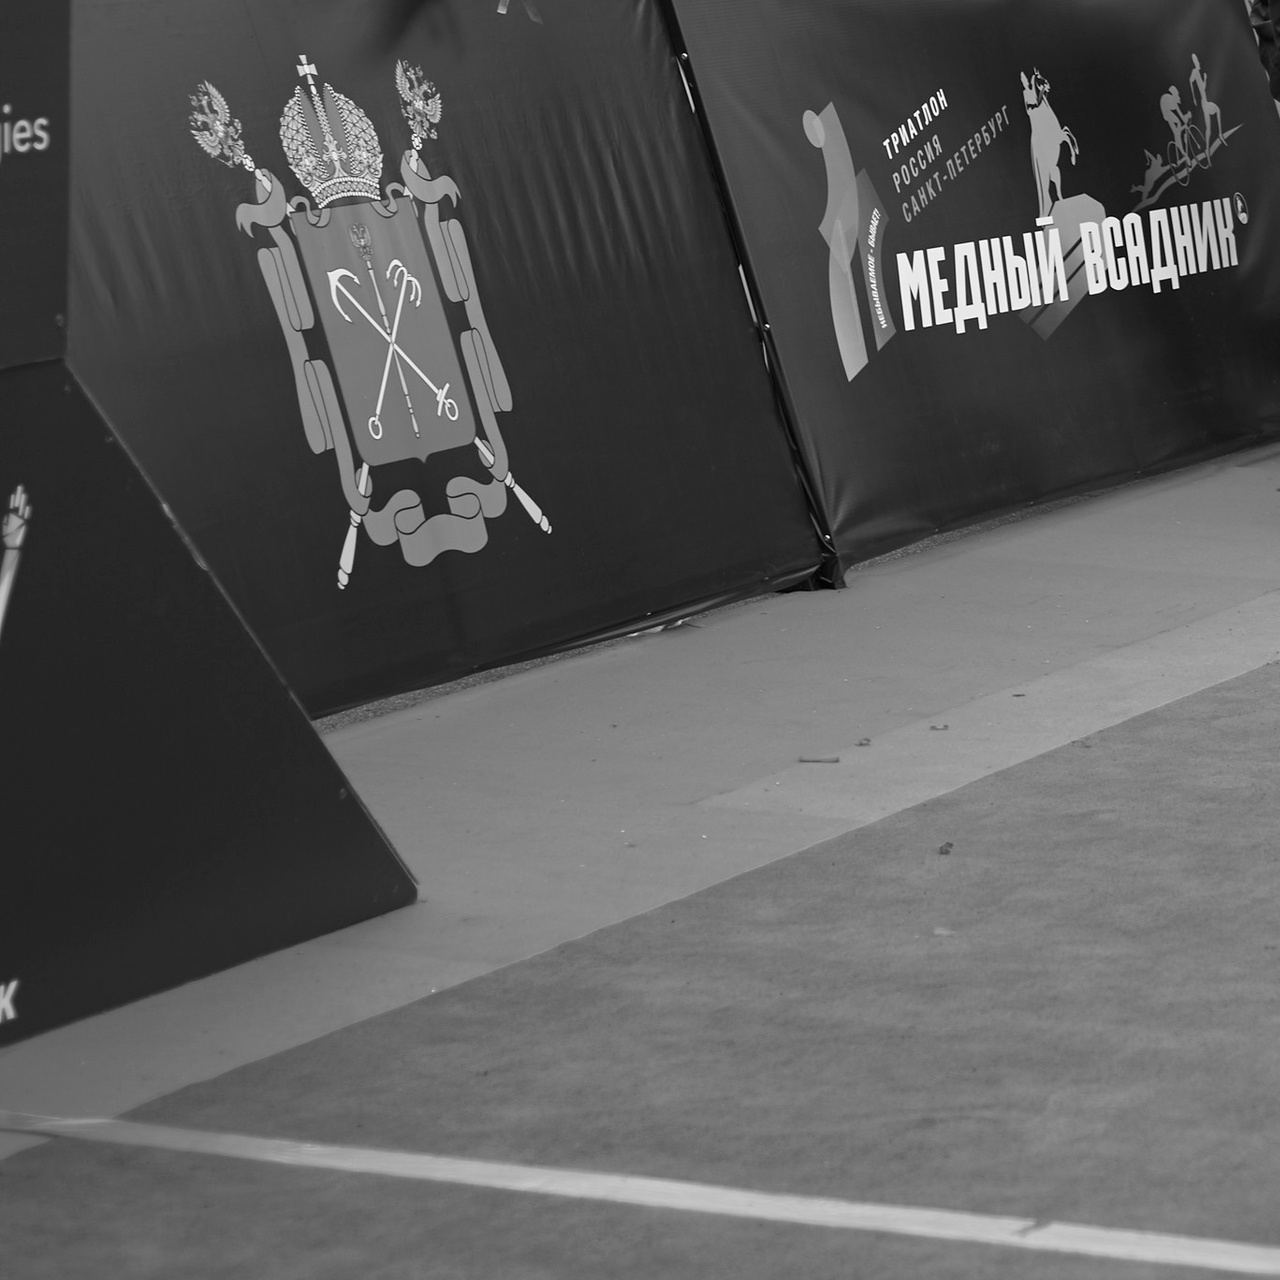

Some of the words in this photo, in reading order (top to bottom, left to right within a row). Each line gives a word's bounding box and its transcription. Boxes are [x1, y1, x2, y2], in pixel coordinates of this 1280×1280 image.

[0, 104, 50, 161] ies
[882, 88, 949, 160] ТРИАТЛОН
[892, 134, 943, 194] РОССИЯ
[901, 105, 1010, 223] САНКТ-ПЕТЕРБУРГ
[867, 253, 889, 330] НЕБЫВАЕМОЕ
[896, 216, 1070, 335] МЕДНЫЙ
[1079, 197, 1239, 294] ВСАДНИК
